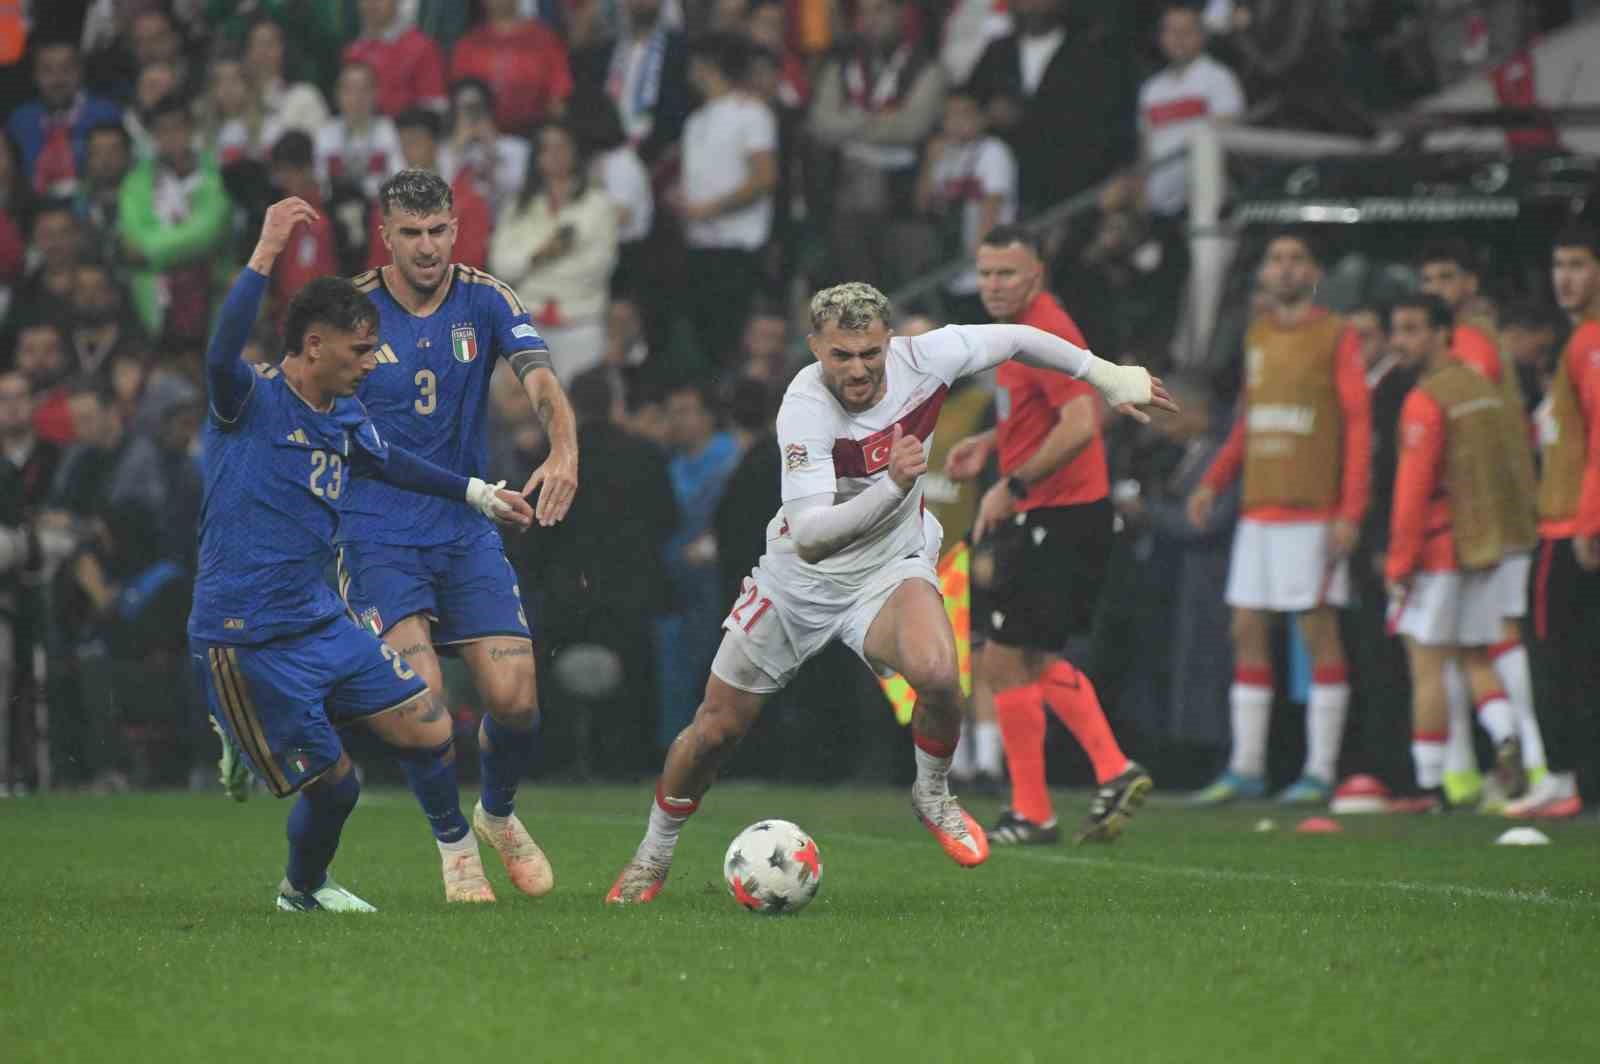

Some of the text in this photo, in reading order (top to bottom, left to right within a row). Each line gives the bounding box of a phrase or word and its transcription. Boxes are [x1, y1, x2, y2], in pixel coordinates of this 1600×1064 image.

[453, 329, 474, 338] ITALIA
[414, 368, 437, 416] 3
[310, 449, 342, 500] 23
[731, 579, 775, 633] 21
